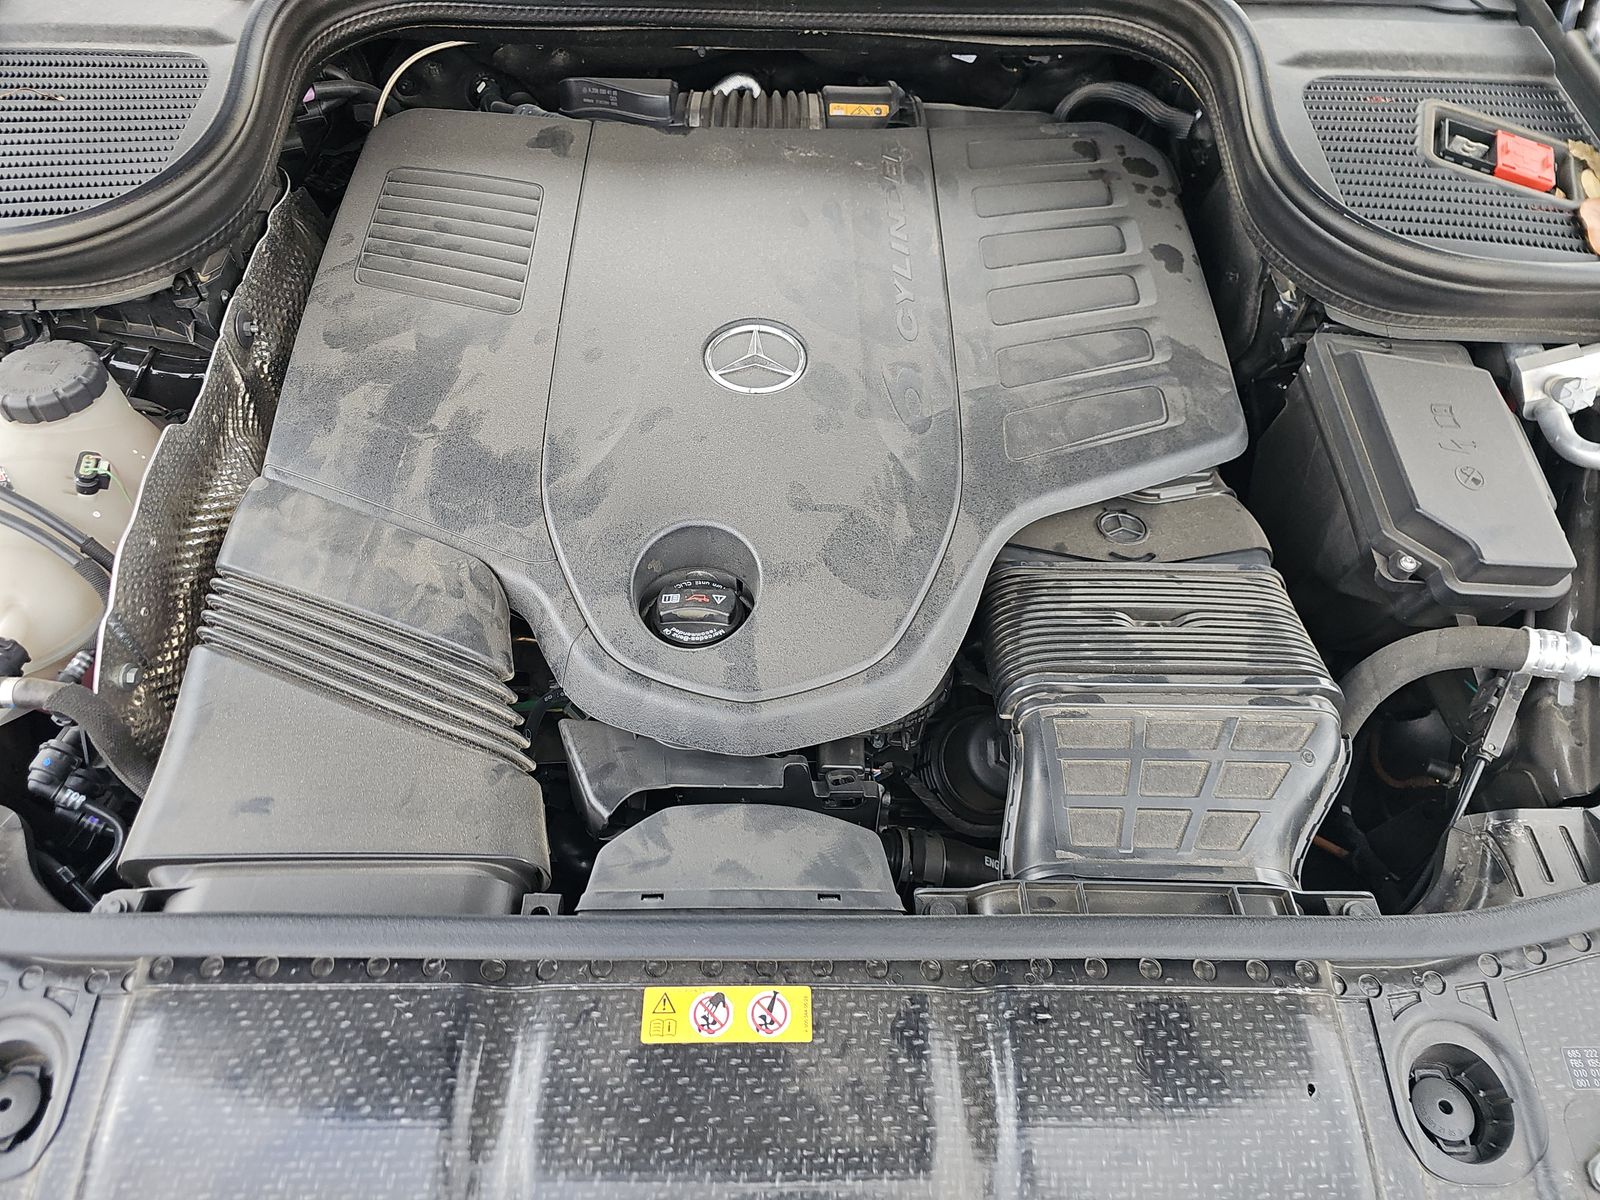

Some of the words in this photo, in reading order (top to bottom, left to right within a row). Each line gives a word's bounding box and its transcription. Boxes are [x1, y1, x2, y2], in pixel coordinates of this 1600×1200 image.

[670, 626, 717, 637] recommended
[672, 628, 726, 642] Mercedes-Benz
[1583, 1049, 1599, 1058] 222
[1573, 1069, 1588, 1078] 010
